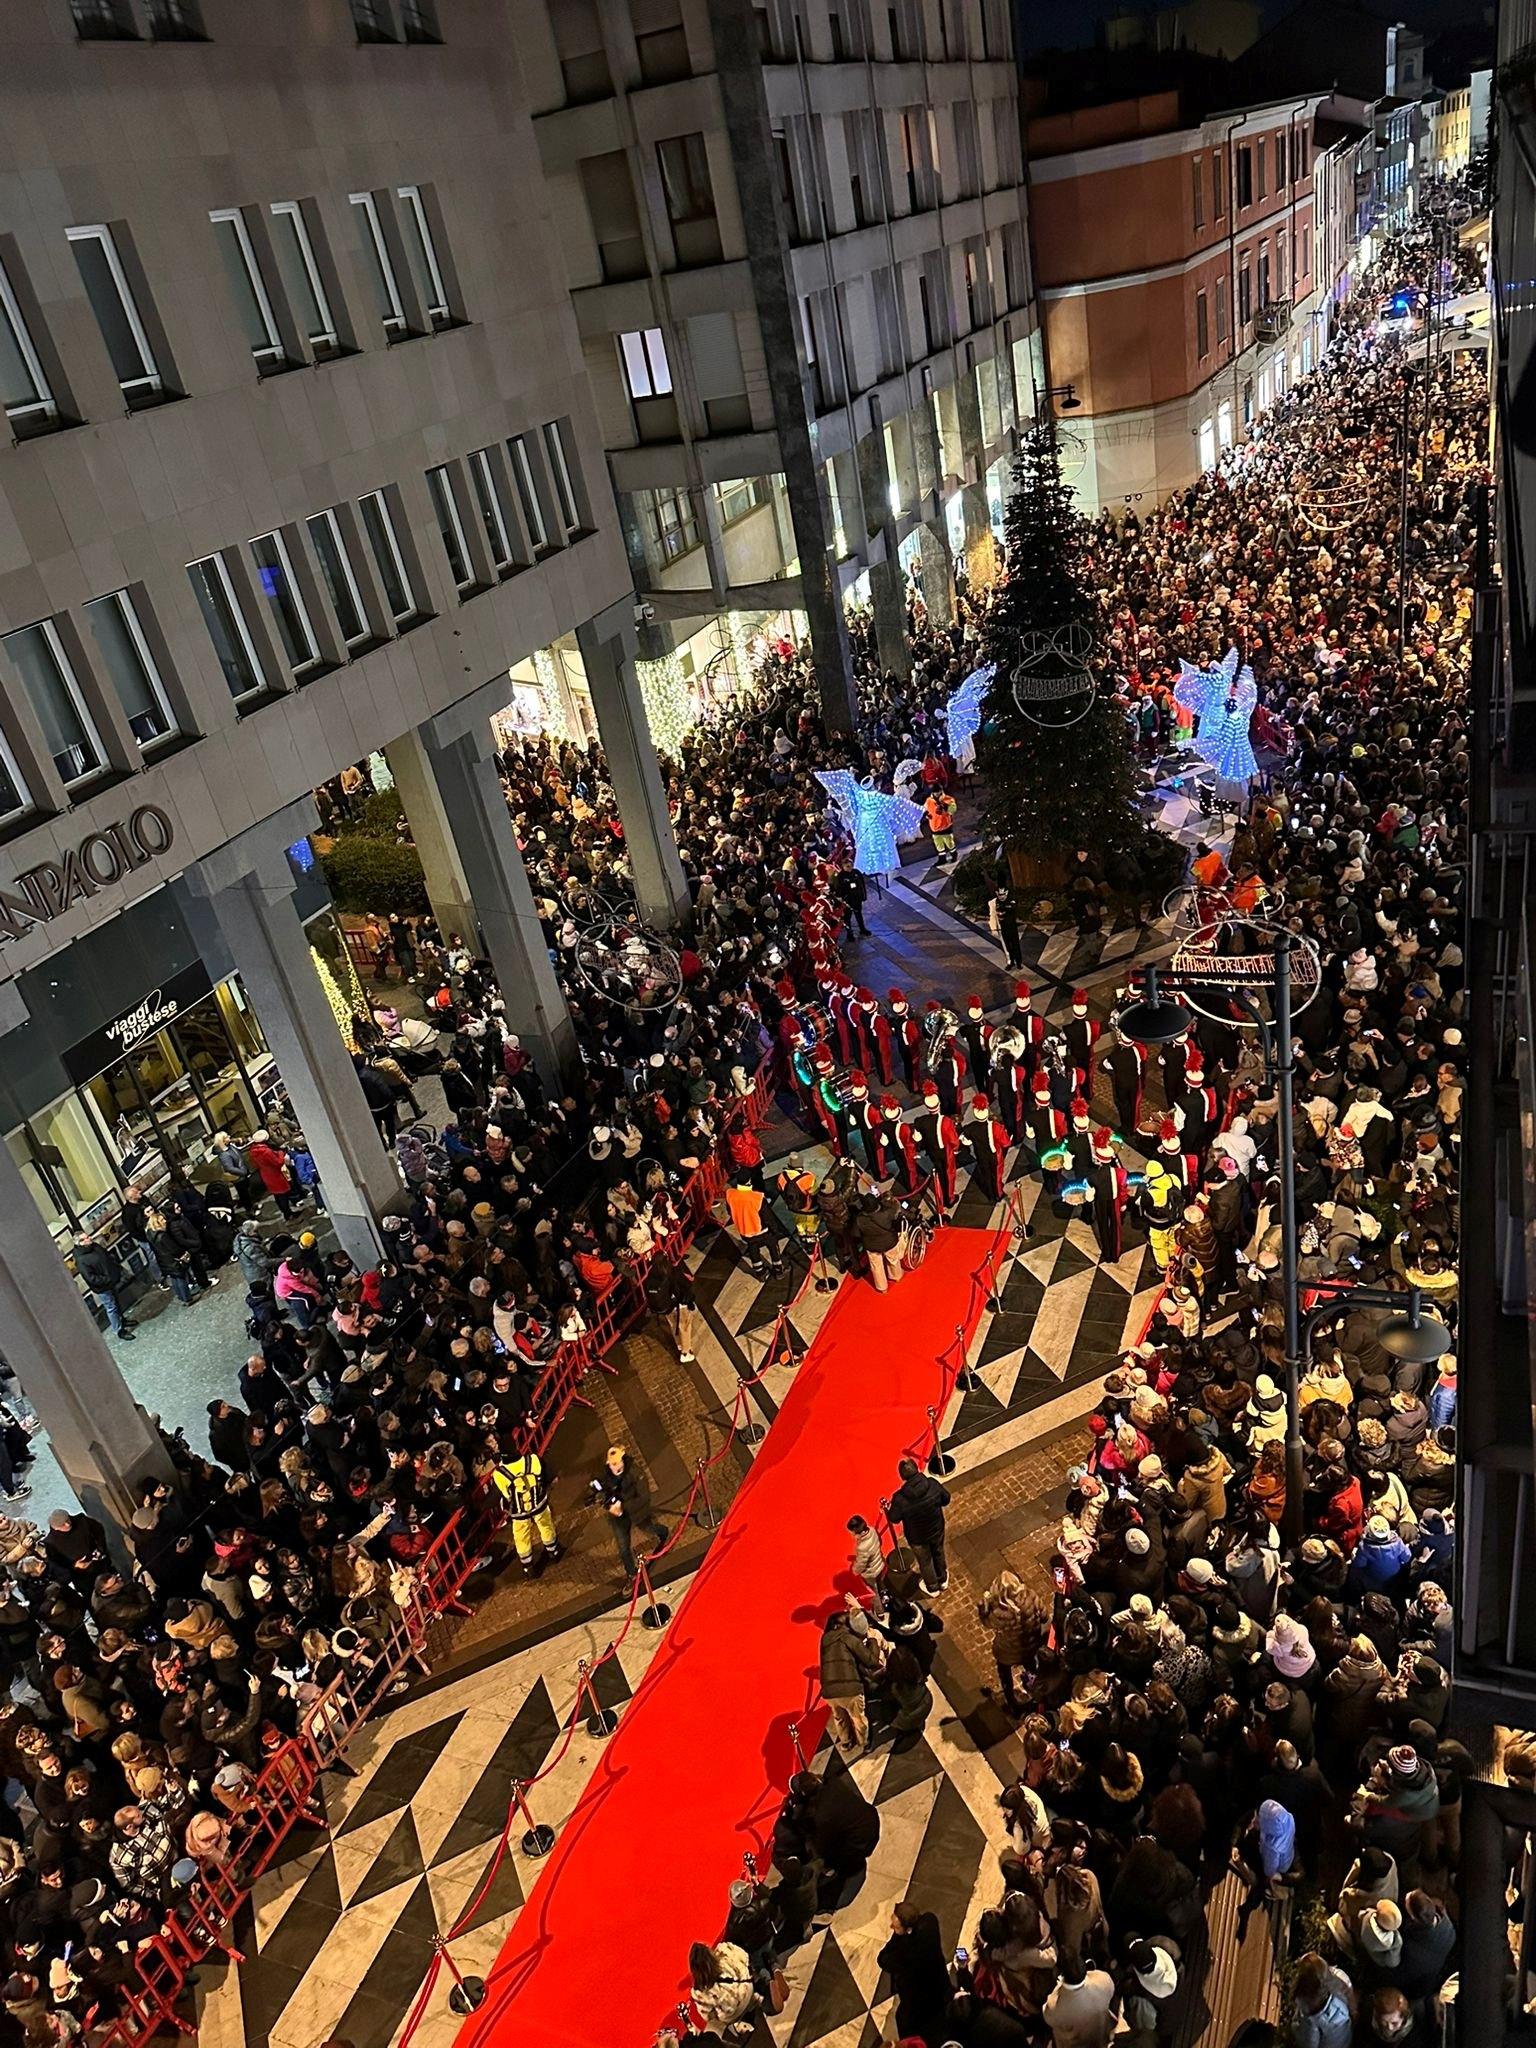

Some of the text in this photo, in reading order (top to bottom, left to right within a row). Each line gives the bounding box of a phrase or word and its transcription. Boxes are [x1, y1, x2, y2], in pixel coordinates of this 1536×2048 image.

[0, 804, 173, 943] NPAOLO
[105, 1000, 150, 1040] viaggi
[122, 1000, 178, 1045] bustese
